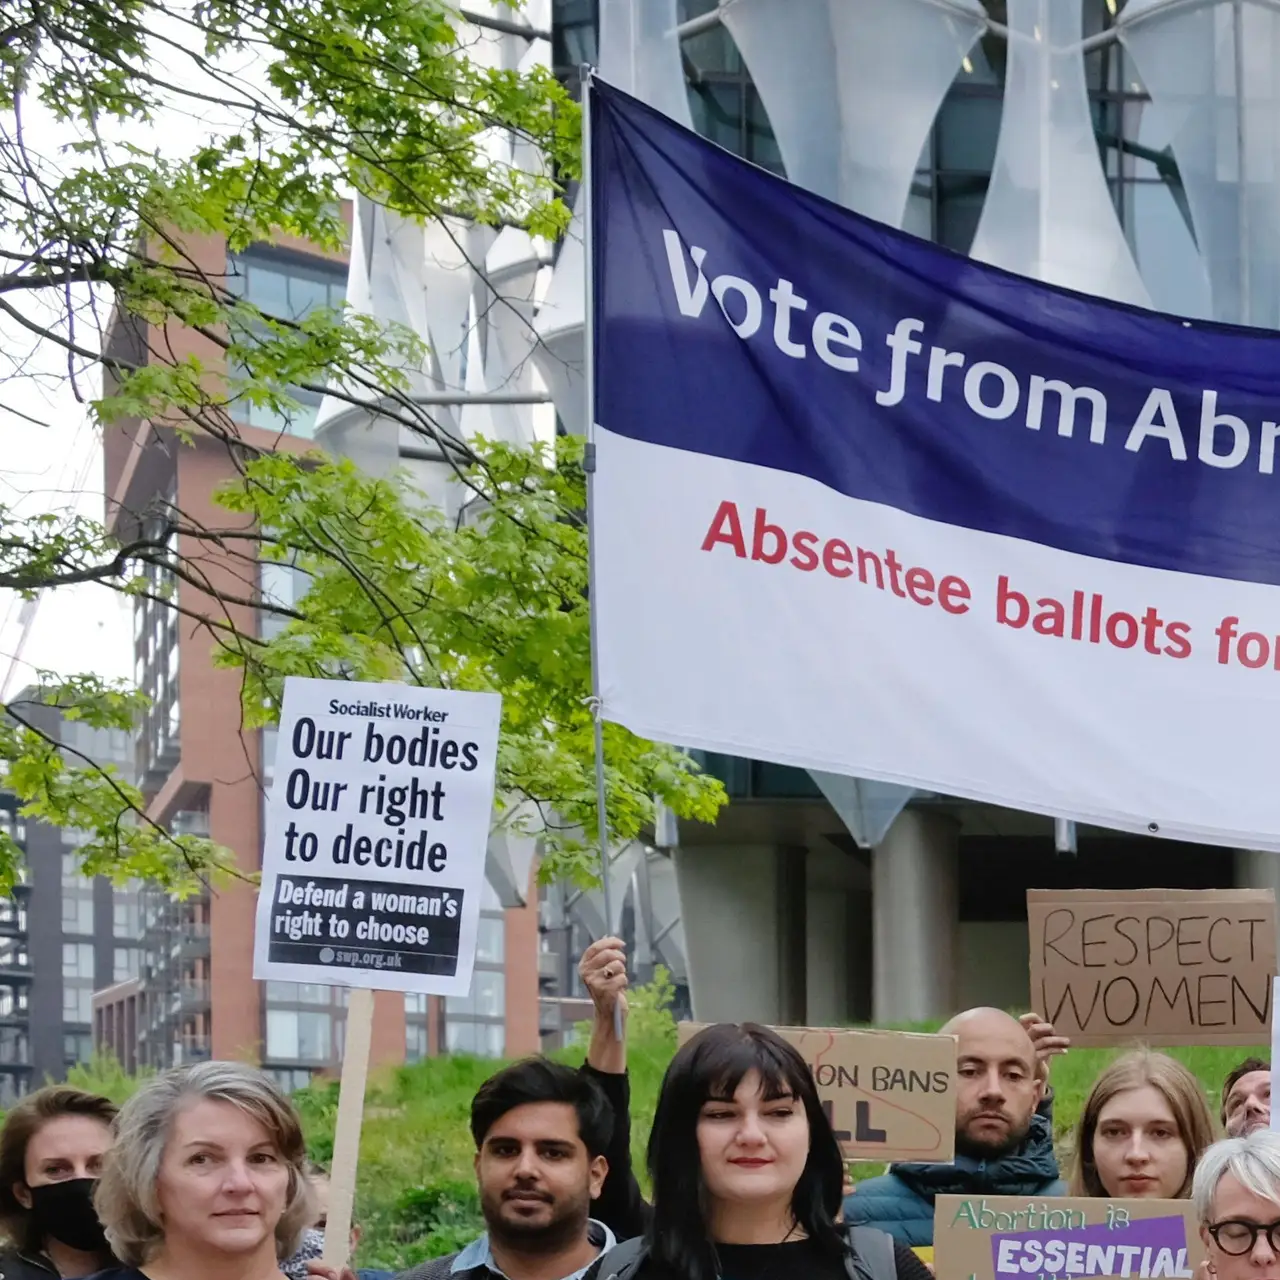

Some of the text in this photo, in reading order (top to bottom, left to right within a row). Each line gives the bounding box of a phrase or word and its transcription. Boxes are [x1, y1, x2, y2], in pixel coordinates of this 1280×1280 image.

[700, 500, 971, 615] Absentee
[995, 574, 1193, 659] ballots
[292, 717, 479, 771] Our bodies
[286, 768, 445, 827] Our right
[284, 822, 447, 873] to decide
[279, 880, 458, 918] Defend a woman's
[275, 913, 429, 946] right to choose
[1042, 908, 1266, 967] RESPECT
[1041, 974, 1273, 1031] WOMEN
[872, 1066, 949, 1093] BANS
[948, 1200, 1130, 1231] Abortion is
[997, 1239, 1194, 1280] ESSENTIAL
